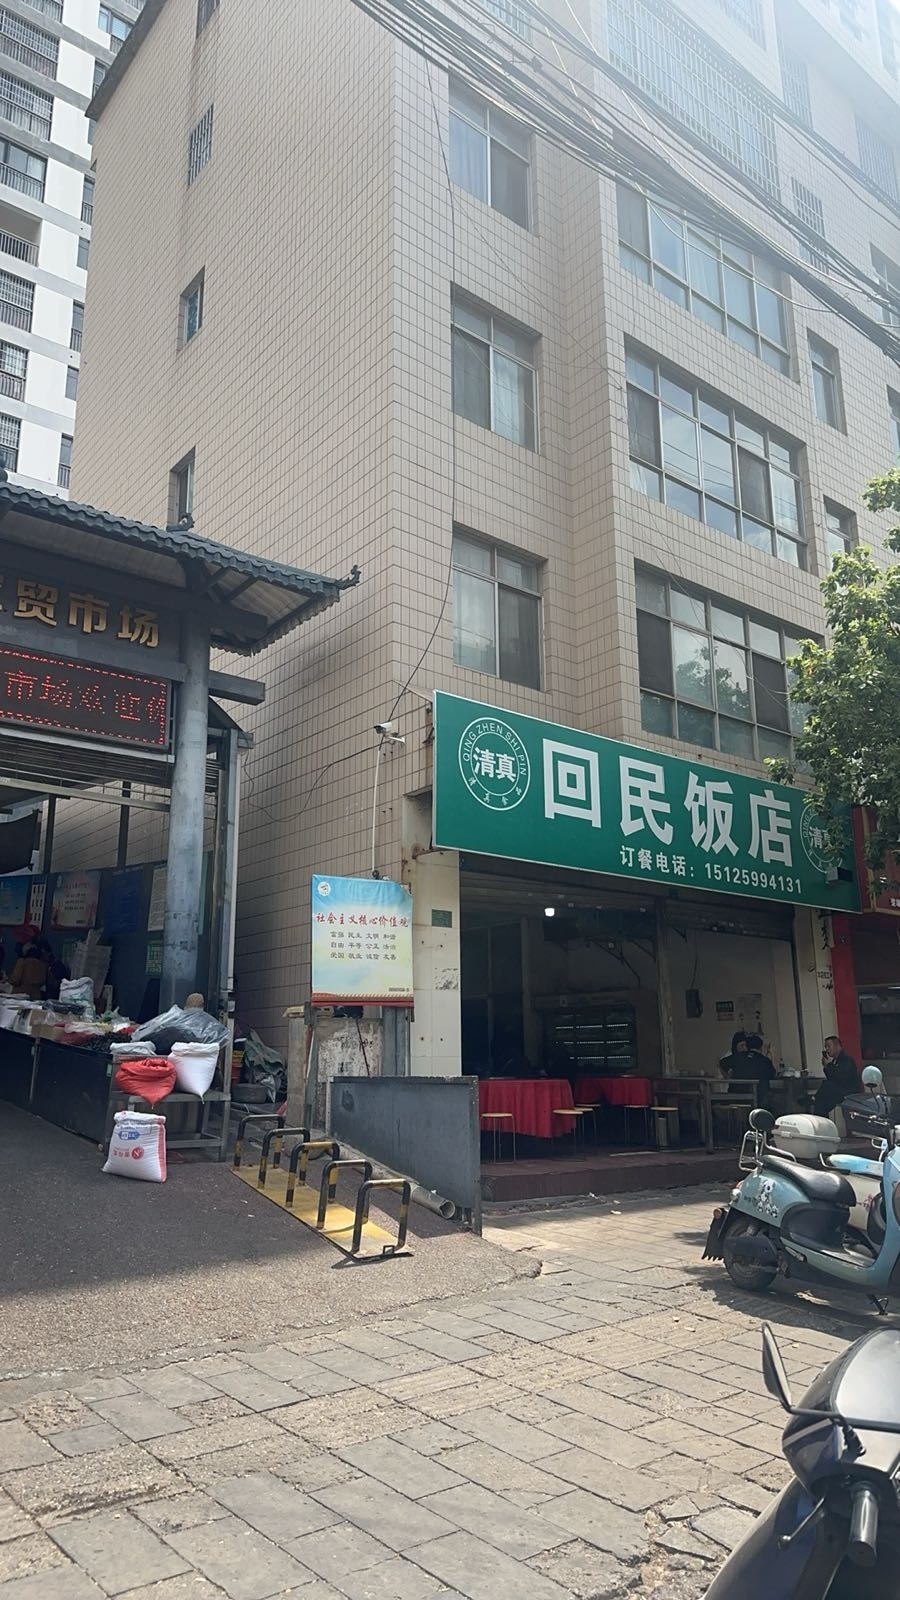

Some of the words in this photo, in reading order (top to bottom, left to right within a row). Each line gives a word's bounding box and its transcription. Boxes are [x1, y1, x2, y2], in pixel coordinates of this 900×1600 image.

[0, 575, 160, 648] 贸市场
[462, 731, 477, 762] QING
[475, 722, 504, 735] ZHEN
[504, 731, 521, 752] SHI
[517, 754, 527, 776] PIN
[473, 746, 517, 783] 清真
[542, 738, 793, 868] 回民饭店
[704, 862, 803, 896] 15125994131
[316, 912, 409, 928] 社会主义核心价值观
[347, 931, 363, 940] 民主
[365, 932, 380, 940] 文明
[382, 933, 397, 941] 和谐
[330, 941, 345, 949] 自由
[347, 942, 363, 950] 平等
[365, 942, 380, 950] 公正
